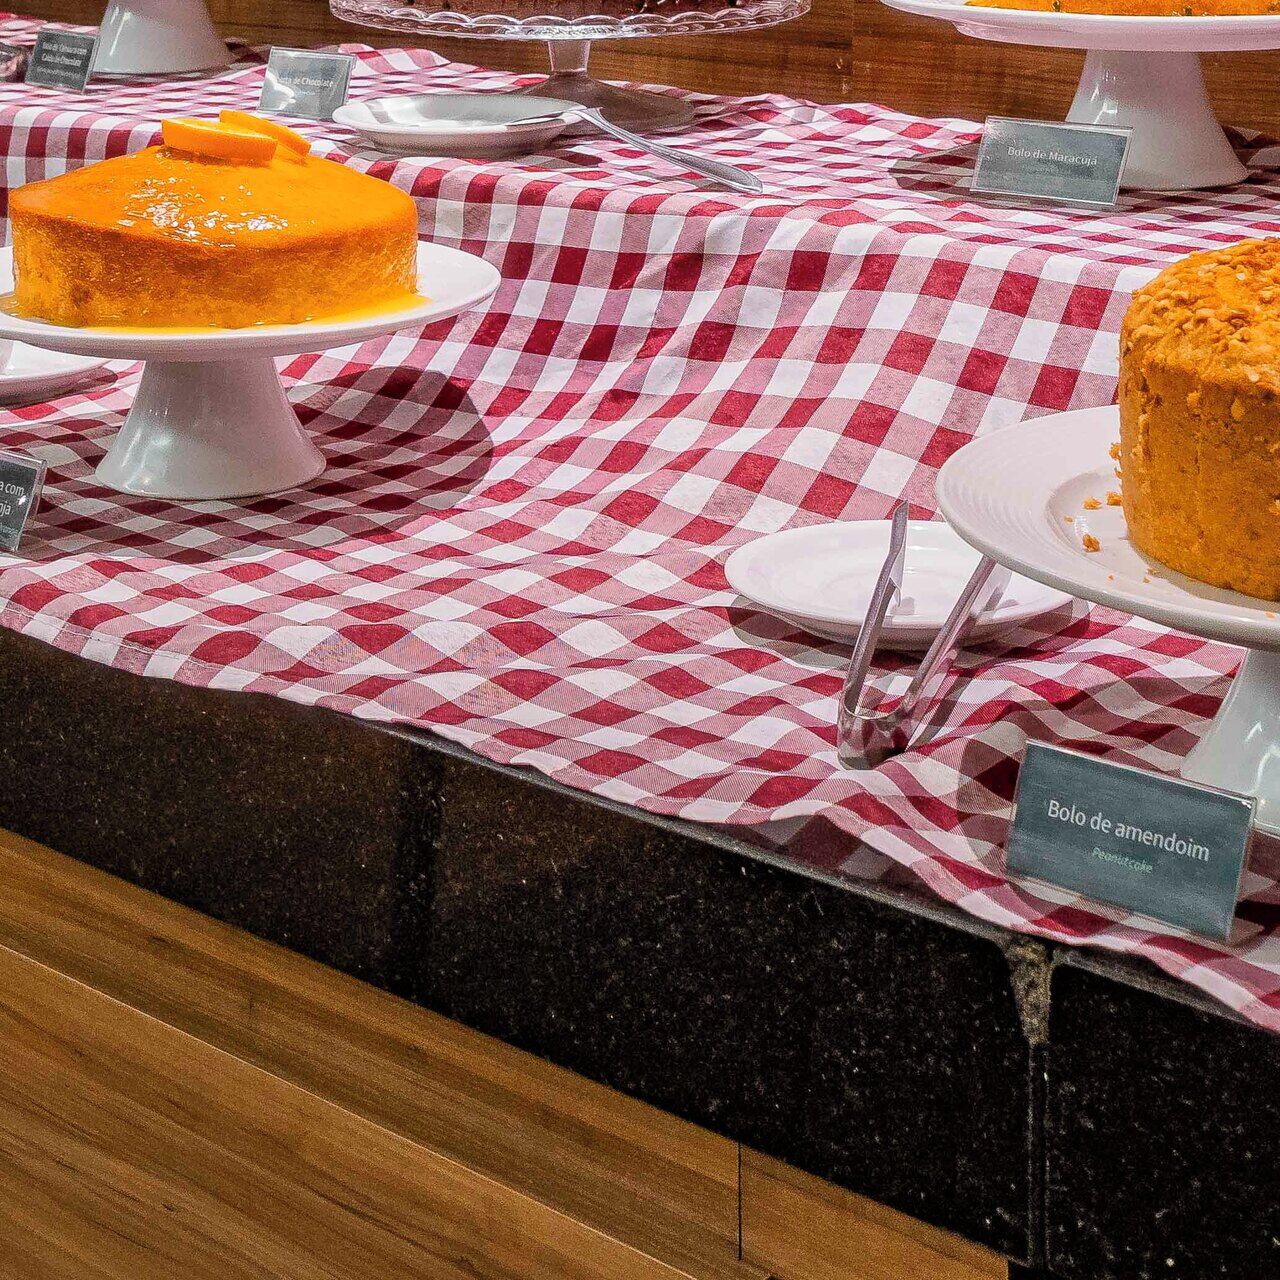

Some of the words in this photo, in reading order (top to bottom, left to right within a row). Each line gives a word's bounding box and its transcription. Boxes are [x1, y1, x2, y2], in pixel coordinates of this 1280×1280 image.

[301, 77, 334, 88] Chocolate
[1007, 146, 1031, 158] Bolo
[1032, 149, 1047, 159] de
[1048, 150, 1097, 166] Maracujá
[5, 482, 25, 497] com
[1047, 799, 1086, 826] Bolo
[1090, 811, 1112, 834] de
[1114, 821, 1211, 862] amendoim
